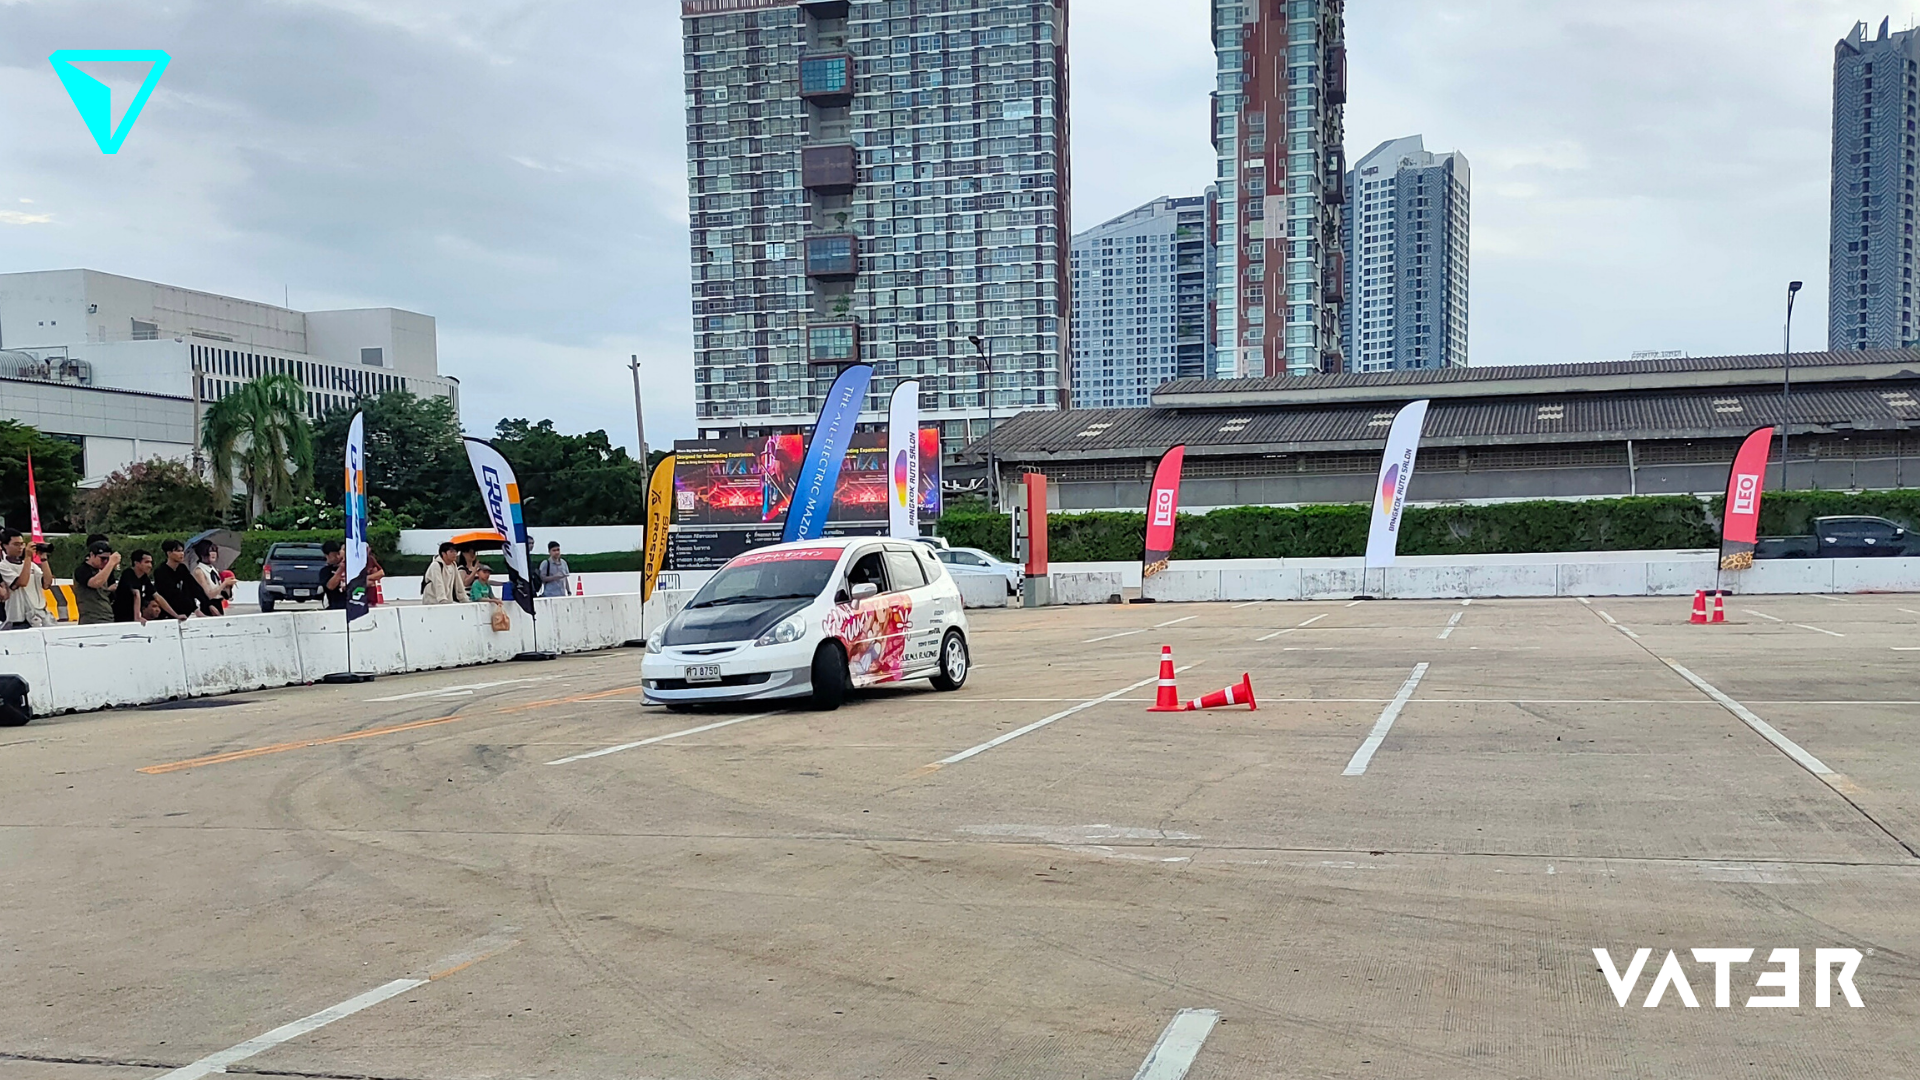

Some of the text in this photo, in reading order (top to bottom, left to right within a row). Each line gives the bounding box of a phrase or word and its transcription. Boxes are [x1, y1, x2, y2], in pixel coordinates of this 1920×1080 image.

[840, 386, 855, 409] THE
[815, 411, 843, 496] ALL-ELECTRIC
[909, 462, 917, 484] AUTO
[1389, 448, 1412, 532] BANGKOK AUTO SALON
[1737, 478, 1753, 509] LEO
[1157, 492, 1170, 521] LEO
[645, 512, 660, 582] PROSPEX
[658, 516, 669, 559] SEI
[699, 666, 718, 676] 8750
